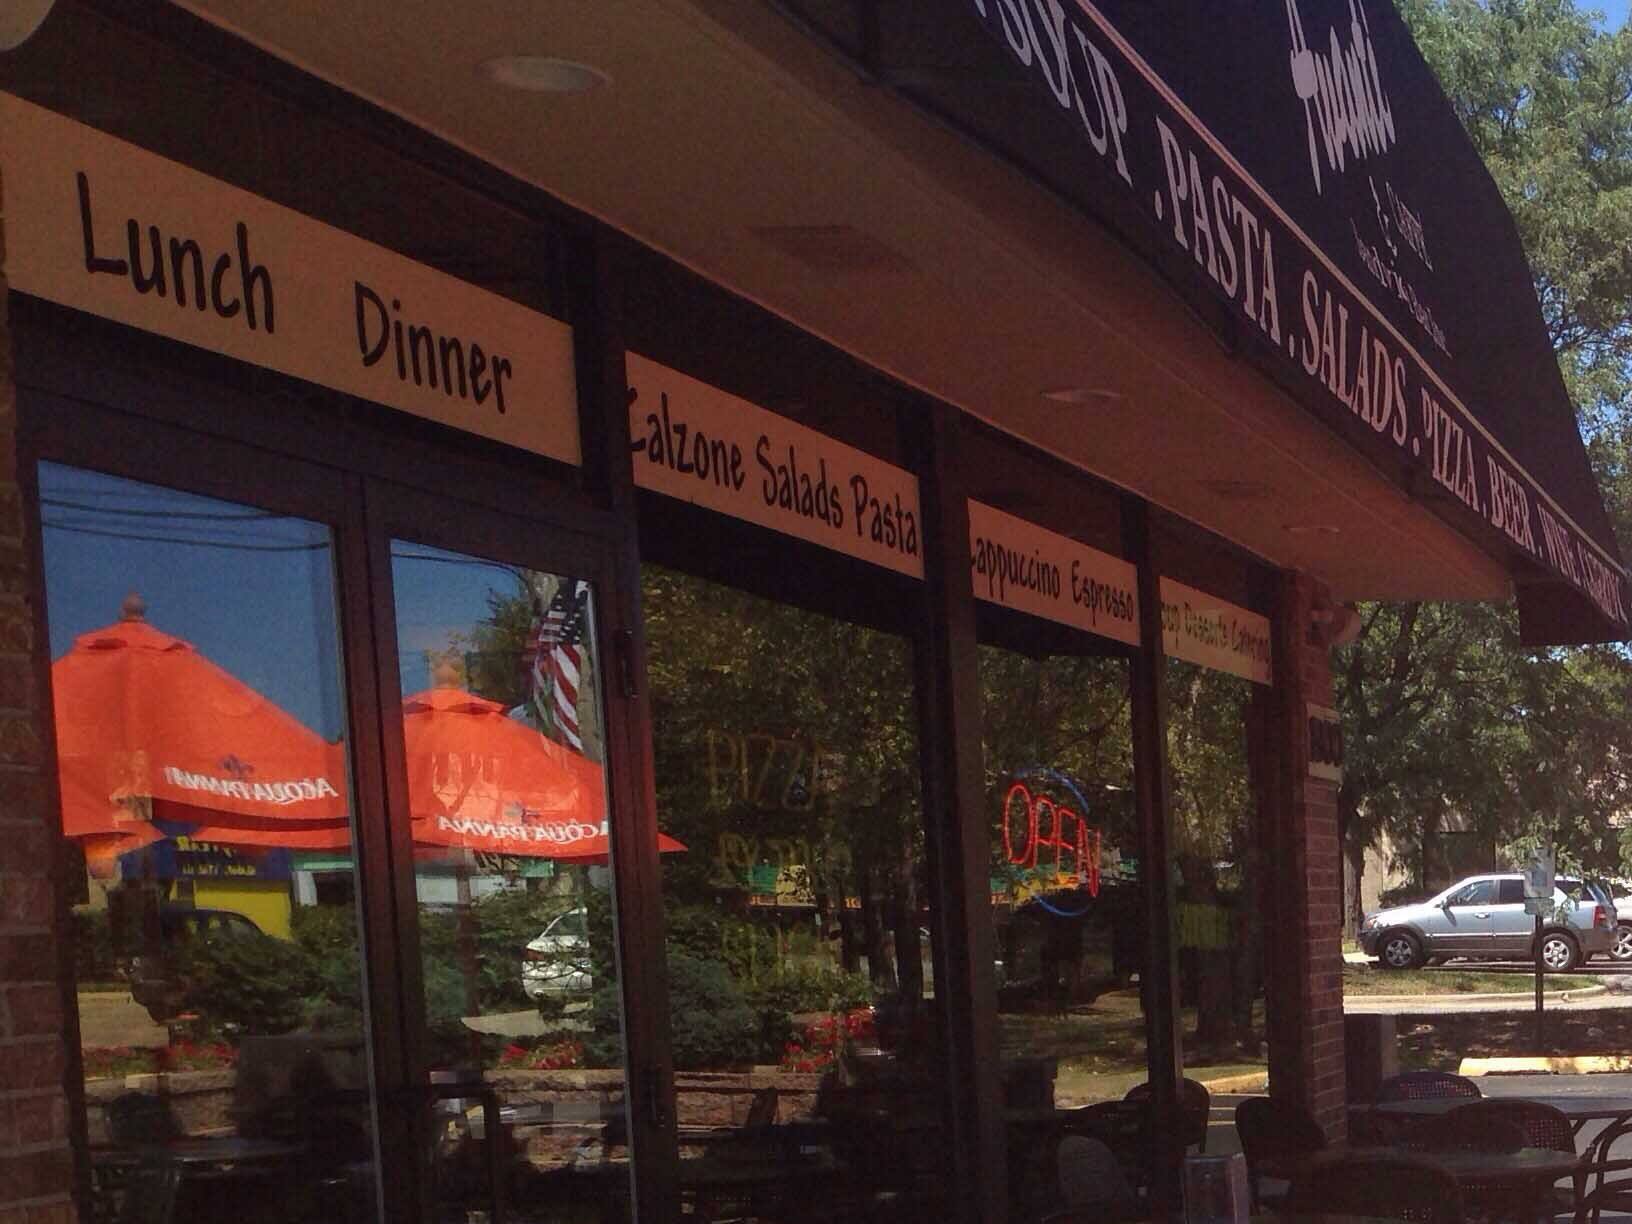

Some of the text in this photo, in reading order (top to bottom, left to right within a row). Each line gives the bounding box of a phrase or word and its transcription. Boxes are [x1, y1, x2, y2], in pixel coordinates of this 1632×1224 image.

[75, 171, 513, 415] Lunch Dinner
[1156, 114, 1281, 346] PASTA
[1302, 269, 1409, 447] SALADS
[1487, 454, 1537, 556] BEER
[755, 435, 844, 529] Salads
[849, 474, 919, 557] Pasta
[970, 536, 1135, 628] appuccino Espresso
[1002, 780, 1102, 899] OPEN
